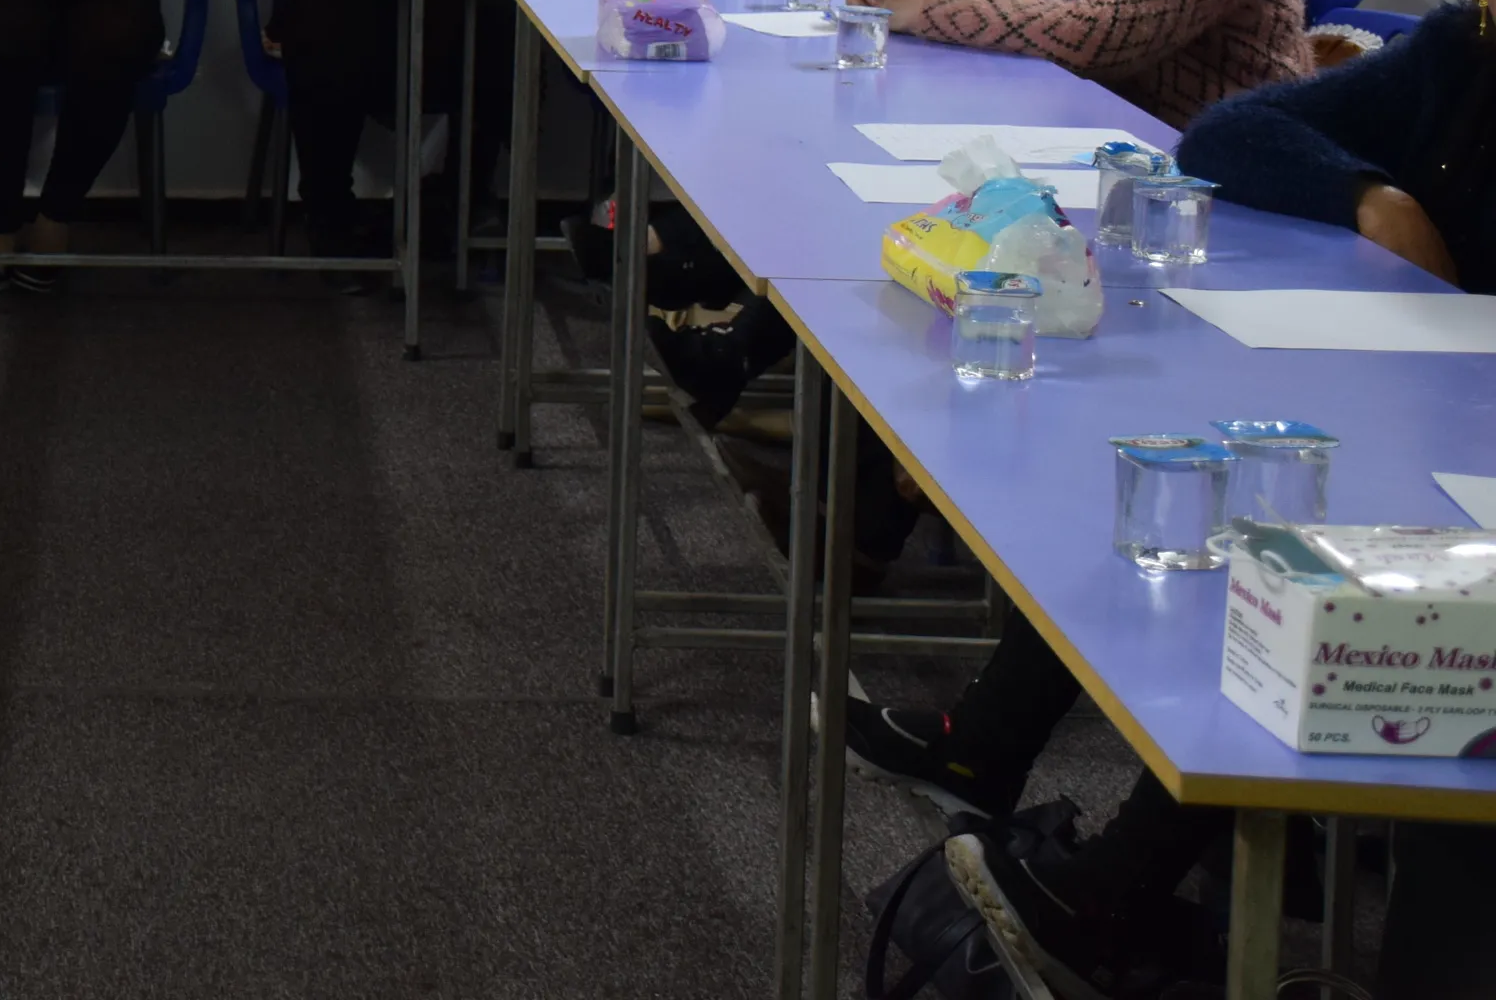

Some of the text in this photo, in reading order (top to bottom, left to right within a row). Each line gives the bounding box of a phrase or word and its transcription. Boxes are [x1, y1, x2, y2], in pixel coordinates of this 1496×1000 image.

[1312, 641, 1420, 669] Mexico
[1343, 680, 1475, 696] Medical Face Mask
[1308, 702, 1353, 712] SURGICAL
[1308, 732, 1321, 742] 50
